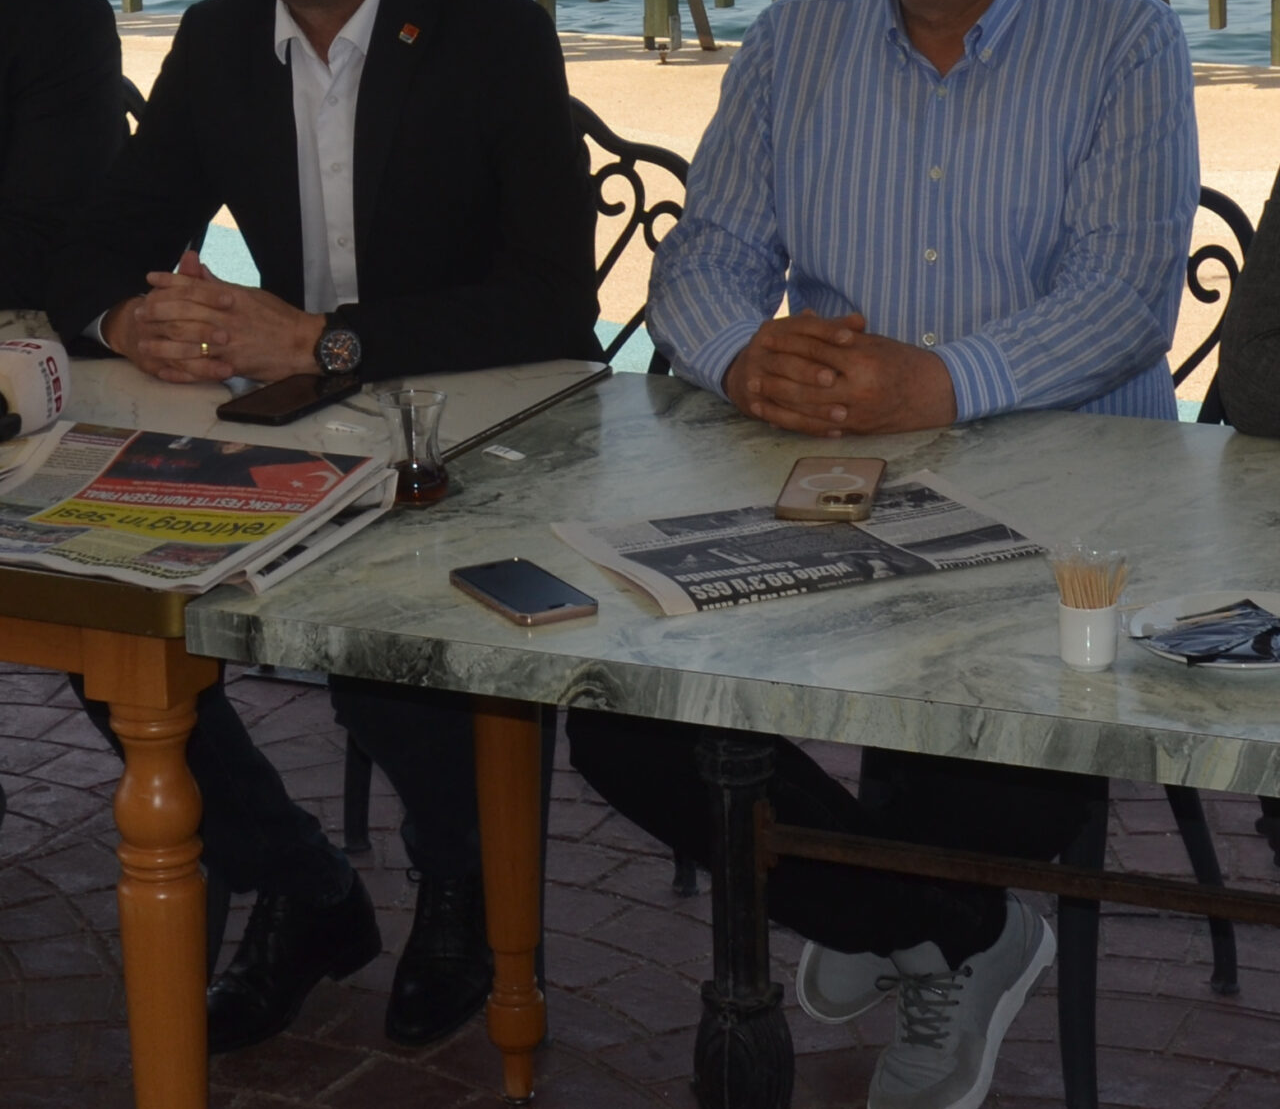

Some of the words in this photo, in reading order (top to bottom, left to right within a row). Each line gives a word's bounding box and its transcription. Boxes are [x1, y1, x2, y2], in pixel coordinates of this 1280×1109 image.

[46, 356, 63, 413] CEP
[51, 508, 115, 524] sesi
[688, 580, 733, 601] GSS
